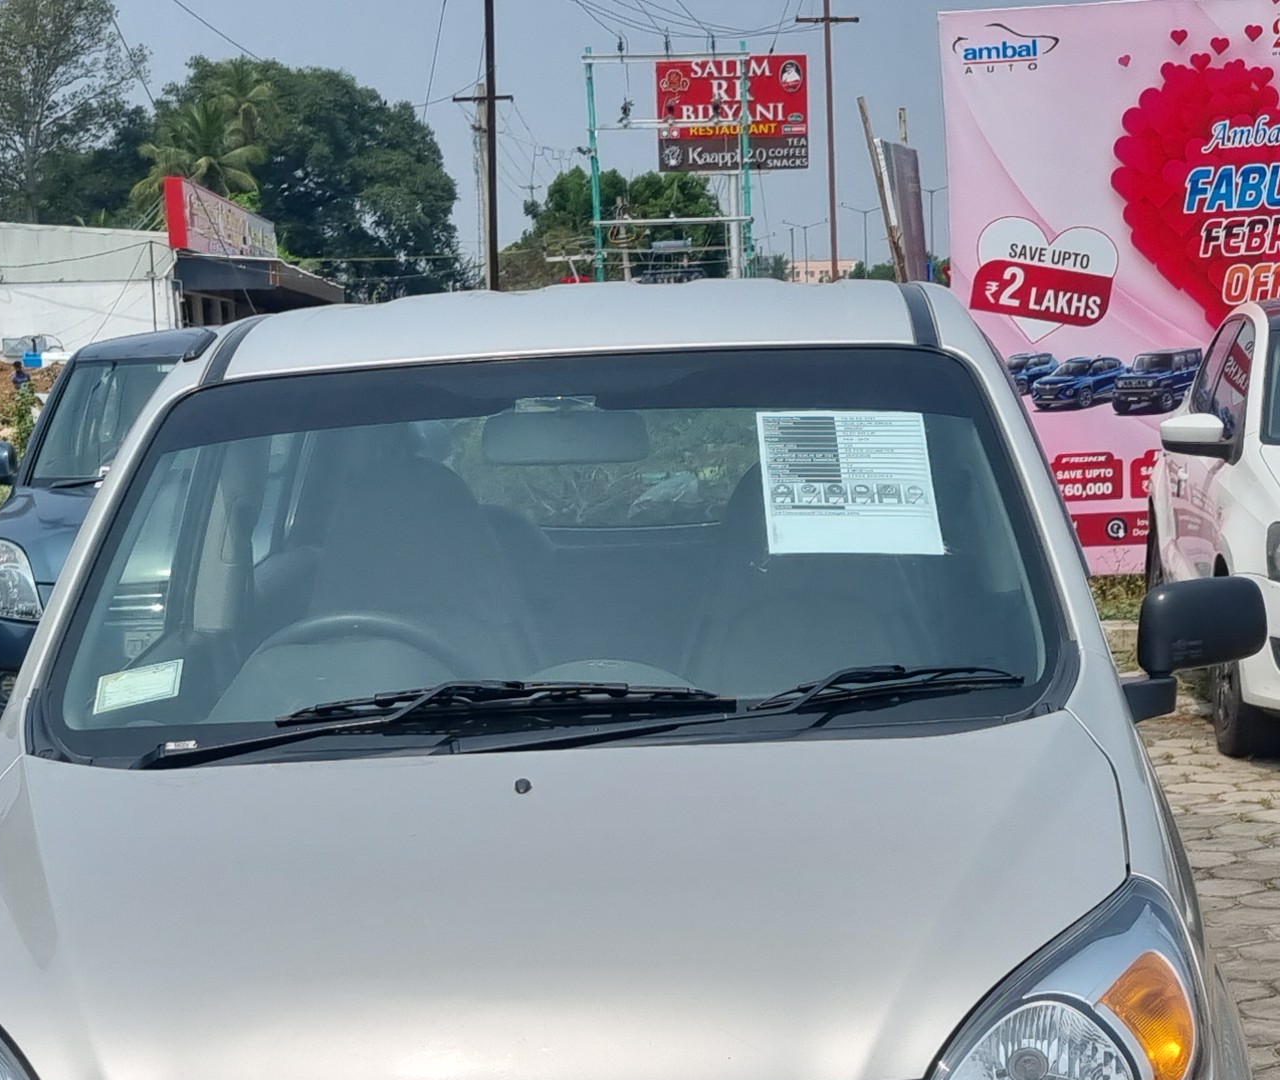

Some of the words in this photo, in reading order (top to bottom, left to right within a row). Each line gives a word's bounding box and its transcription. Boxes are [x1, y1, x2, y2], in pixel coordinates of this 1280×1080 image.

[963, 39, 1037, 61] ambal
[965, 62, 1038, 75] AUTO
[787, 138, 807, 147] TEA
[769, 147, 807, 157] COFFEE
[767, 158, 808, 168] SNACKS
[1008, 243, 1047, 263] SAVE
[1051, 249, 1090, 269] UPTO
[1028, 286, 1101, 320] LAKHS
[1061, 455, 1108, 463] FRONX
[1056, 469, 1083, 480] SAVE
[1085, 468, 1113, 478] UPTO
